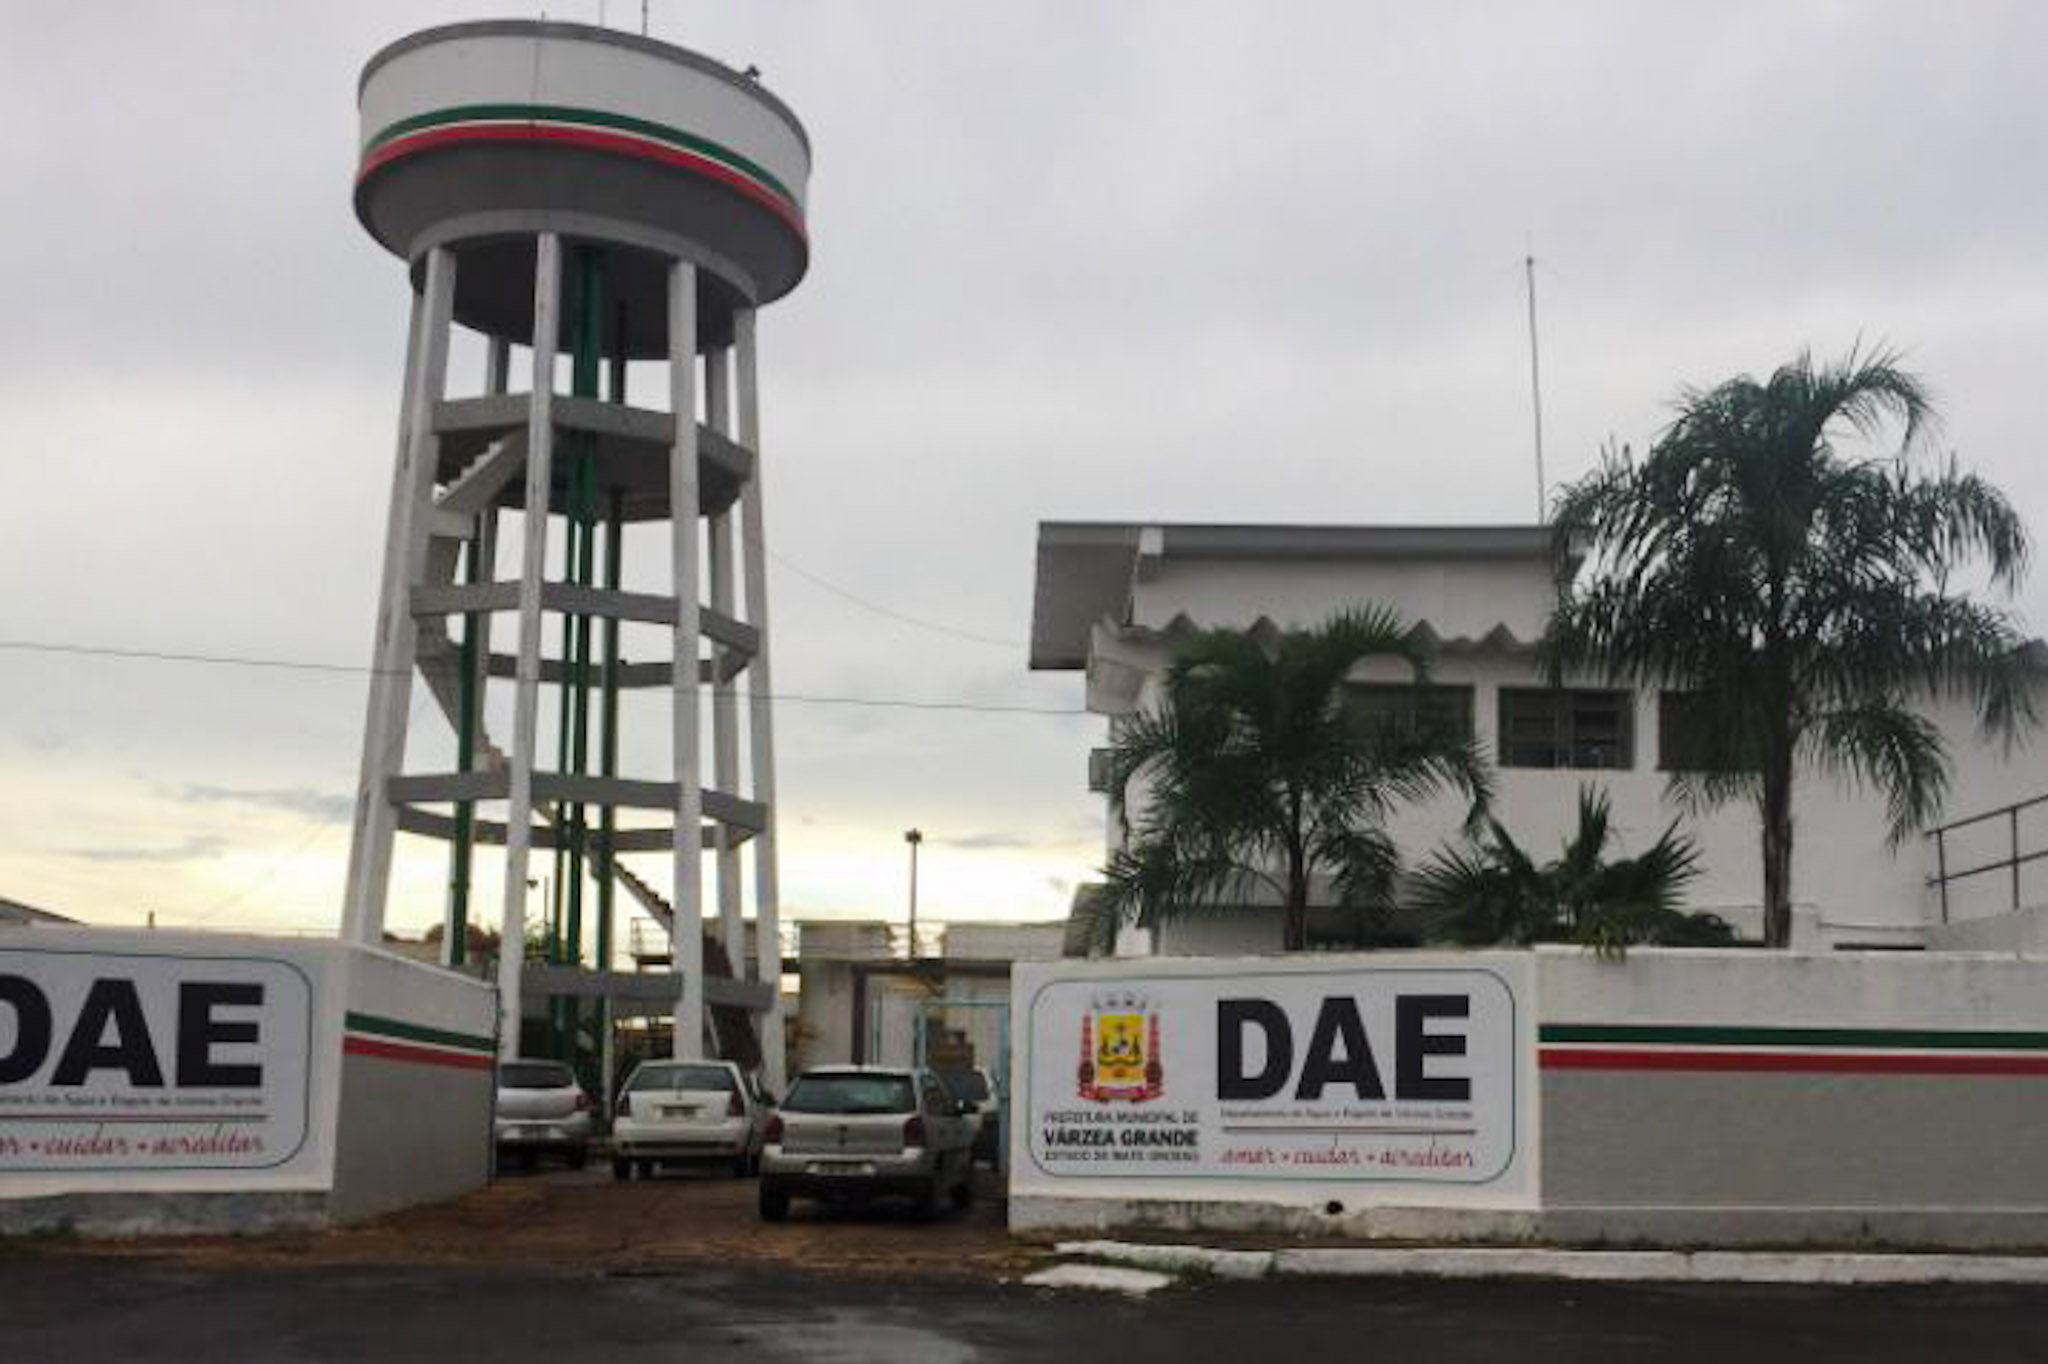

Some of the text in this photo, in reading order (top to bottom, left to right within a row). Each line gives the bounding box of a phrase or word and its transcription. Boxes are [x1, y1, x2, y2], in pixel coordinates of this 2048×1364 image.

[1217, 994, 1472, 1101] DAE
[1044, 1126, 1198, 1146] VÁRZEA GRANDE
